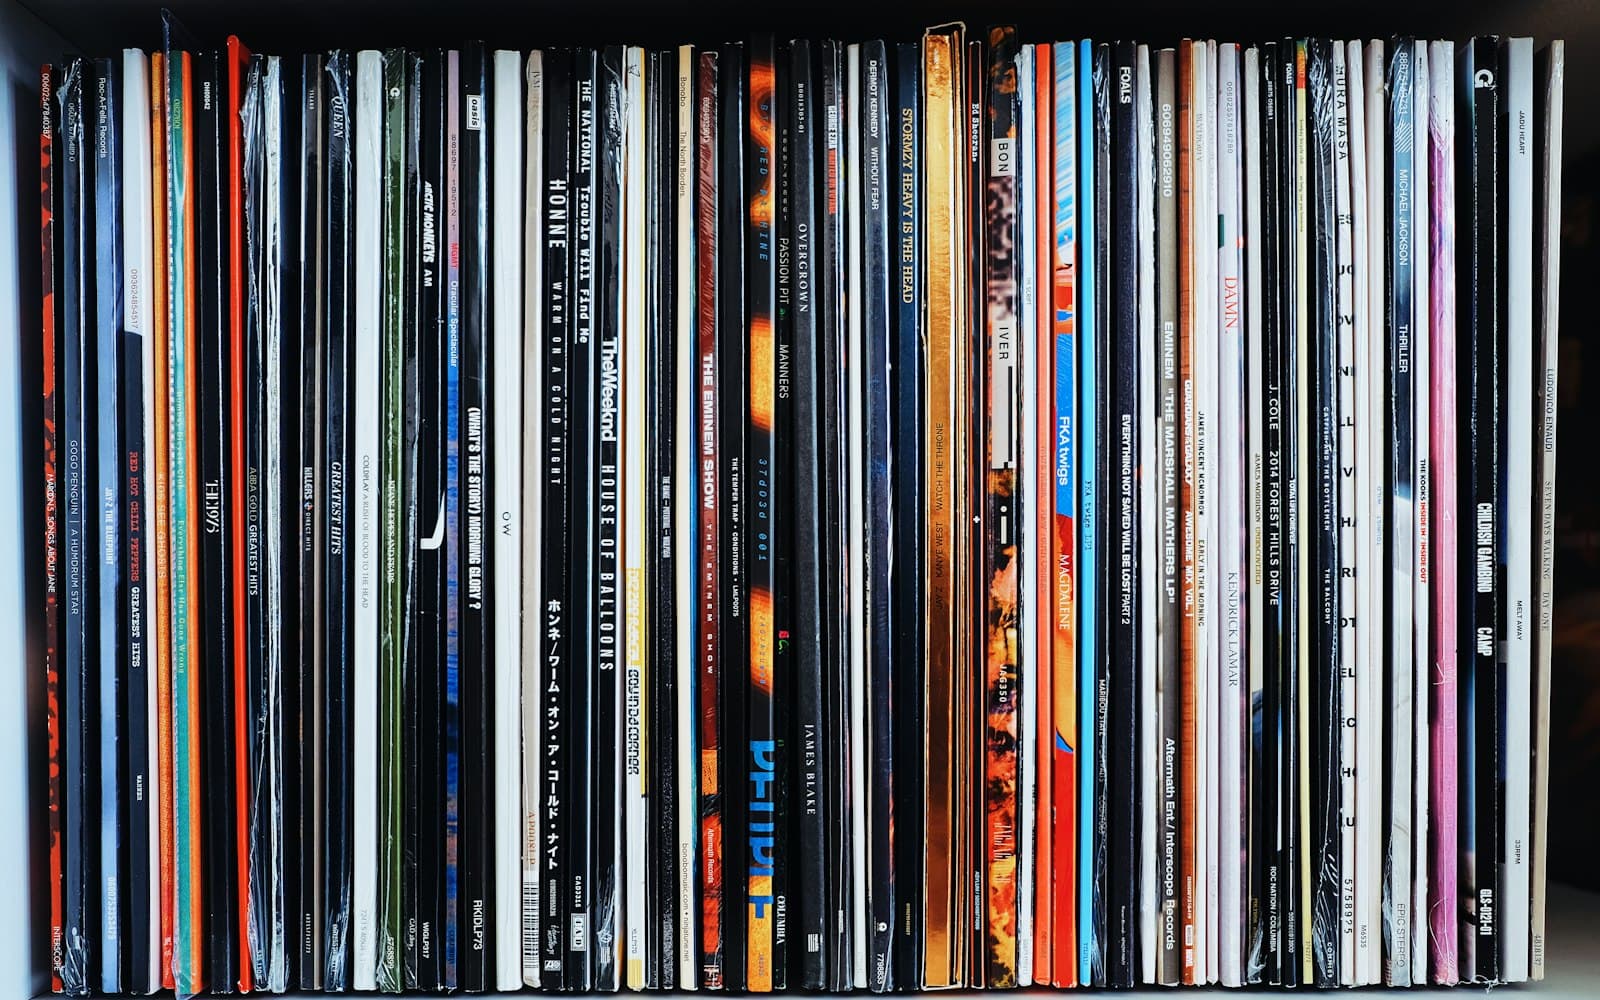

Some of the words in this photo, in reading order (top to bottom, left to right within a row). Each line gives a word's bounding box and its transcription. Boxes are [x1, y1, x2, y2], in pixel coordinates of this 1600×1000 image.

[582, 80, 591, 101] THE
[1120, 67, 1130, 103] FOALS
[41, 73, 50, 139] 00602547840387
[332, 96, 343, 137] QUEEN
[99, 126, 107, 158] Records
[581, 110, 591, 173] NATIONAL
[903, 108, 912, 169] STORMZY
[998, 143, 1008, 172] BON
[1162, 104, 1172, 197] 606949062910
[424, 182, 432, 211] ARCTIC
[903, 173, 912, 218] HEAVY
[1399, 170, 1408, 214] MICHAEL
[548, 179, 565, 248] HONNE
[580, 187, 590, 241] Trouble
[903, 222, 912, 234] IS
[423, 213, 434, 263] MONKEYS
[903, 237, 913, 262] THE
[1399, 217, 1408, 265] JACKSON
[424, 270, 432, 286] AM
[580, 249, 590, 280] Will
[779, 238, 789, 283] PASSION
[798, 224, 808, 313] OVERGROWN
[552, 282, 562, 324] WARM
[580, 289, 590, 319] Find
[780, 288, 789, 304] PIT
[903, 266, 913, 304] HEAD
[1224, 277, 1236, 334] DAMN.
[552, 337, 562, 354] ON
[580, 328, 589, 343] Me
[998, 328, 1009, 360] IVER
[1164, 322, 1174, 379] EMINEM
[1399, 324, 1408, 372] THRILLER
[601, 337, 617, 441] TheWeeknd
[704, 354, 713, 385] THE
[779, 344, 788, 398] MANNERS
[1269, 385, 1277, 394] J.
[551, 386, 561, 424] COLD
[704, 390, 713, 454] EMINEM
[1164, 388, 1174, 422] "THE
[1270, 398, 1278, 430] COLE
[467, 407, 480, 452] (WHAT'S
[1060, 417, 1069, 444] FKA
[1121, 414, 1131, 475] EVERYTHING
[129, 452, 138, 472] RED
[468, 456, 480, 474] THE
[551, 437, 561, 485] NIGHT
[1057, 447, 1070, 486] twigs
[1164, 426, 1174, 500] MARSHALL
[1270, 451, 1278, 478] 2014
[157, 474, 165, 500] KIDS
[331, 462, 341, 524] GREATEST
[468, 476, 481, 514] STORY)
[601, 465, 615, 525] HOUSE
[704, 460, 713, 509] SHOW
[1122, 476, 1130, 496] NOT
[1270, 482, 1278, 528] FOREST
[130, 501, 139, 532] CHILI
[157, 506, 165, 528] SEE
[362, 522, 369, 531] OF
[1122, 497, 1130, 529] SAVED
[1476, 503, 1491, 544] CHILDISH
[130, 538, 139, 581] PEPPERS
[249, 525, 258, 572] GREATEST
[332, 526, 341, 554] HITS
[469, 517, 481, 564] MORNING
[601, 539, 614, 559] OF
[1122, 531, 1130, 553] WILL
[1165, 507, 1174, 575] MATHERS
[1270, 533, 1278, 565] HILLS
[1543, 538, 1551, 580] WALKING
[362, 561, 368, 571] TO
[1122, 555, 1130, 567] BE
[1122, 569, 1130, 593] LOST
[1477, 548, 1491, 592] GAMBINO
[469, 567, 481, 599] GLORY
[1058, 554, 1069, 630] MAGDALENE
[1165, 579, 1175, 603] LP"
[1270, 571, 1278, 606] DRIVE
[131, 587, 140, 638] GREATEST
[600, 573, 615, 670] BALLOONS
[1122, 594, 1130, 616] PART
[1228, 572, 1238, 637] KENDRICK
[132, 643, 140, 668] HITS
[1477, 628, 1491, 656] CAMP
[1228, 641, 1238, 687] LAMAR
[804, 725, 815, 765] JAMES
[1165, 738, 1175, 797] Aftermath
[806, 773, 816, 814] BLAKE
[1164, 832, 1175, 895] Interscope
[473, 900, 482, 950] RKIDLP73
[776, 896, 786, 944] COLUMBIA
[1165, 900, 1175, 950] Records
[1479, 889, 1492, 935] GLS-0121-01
